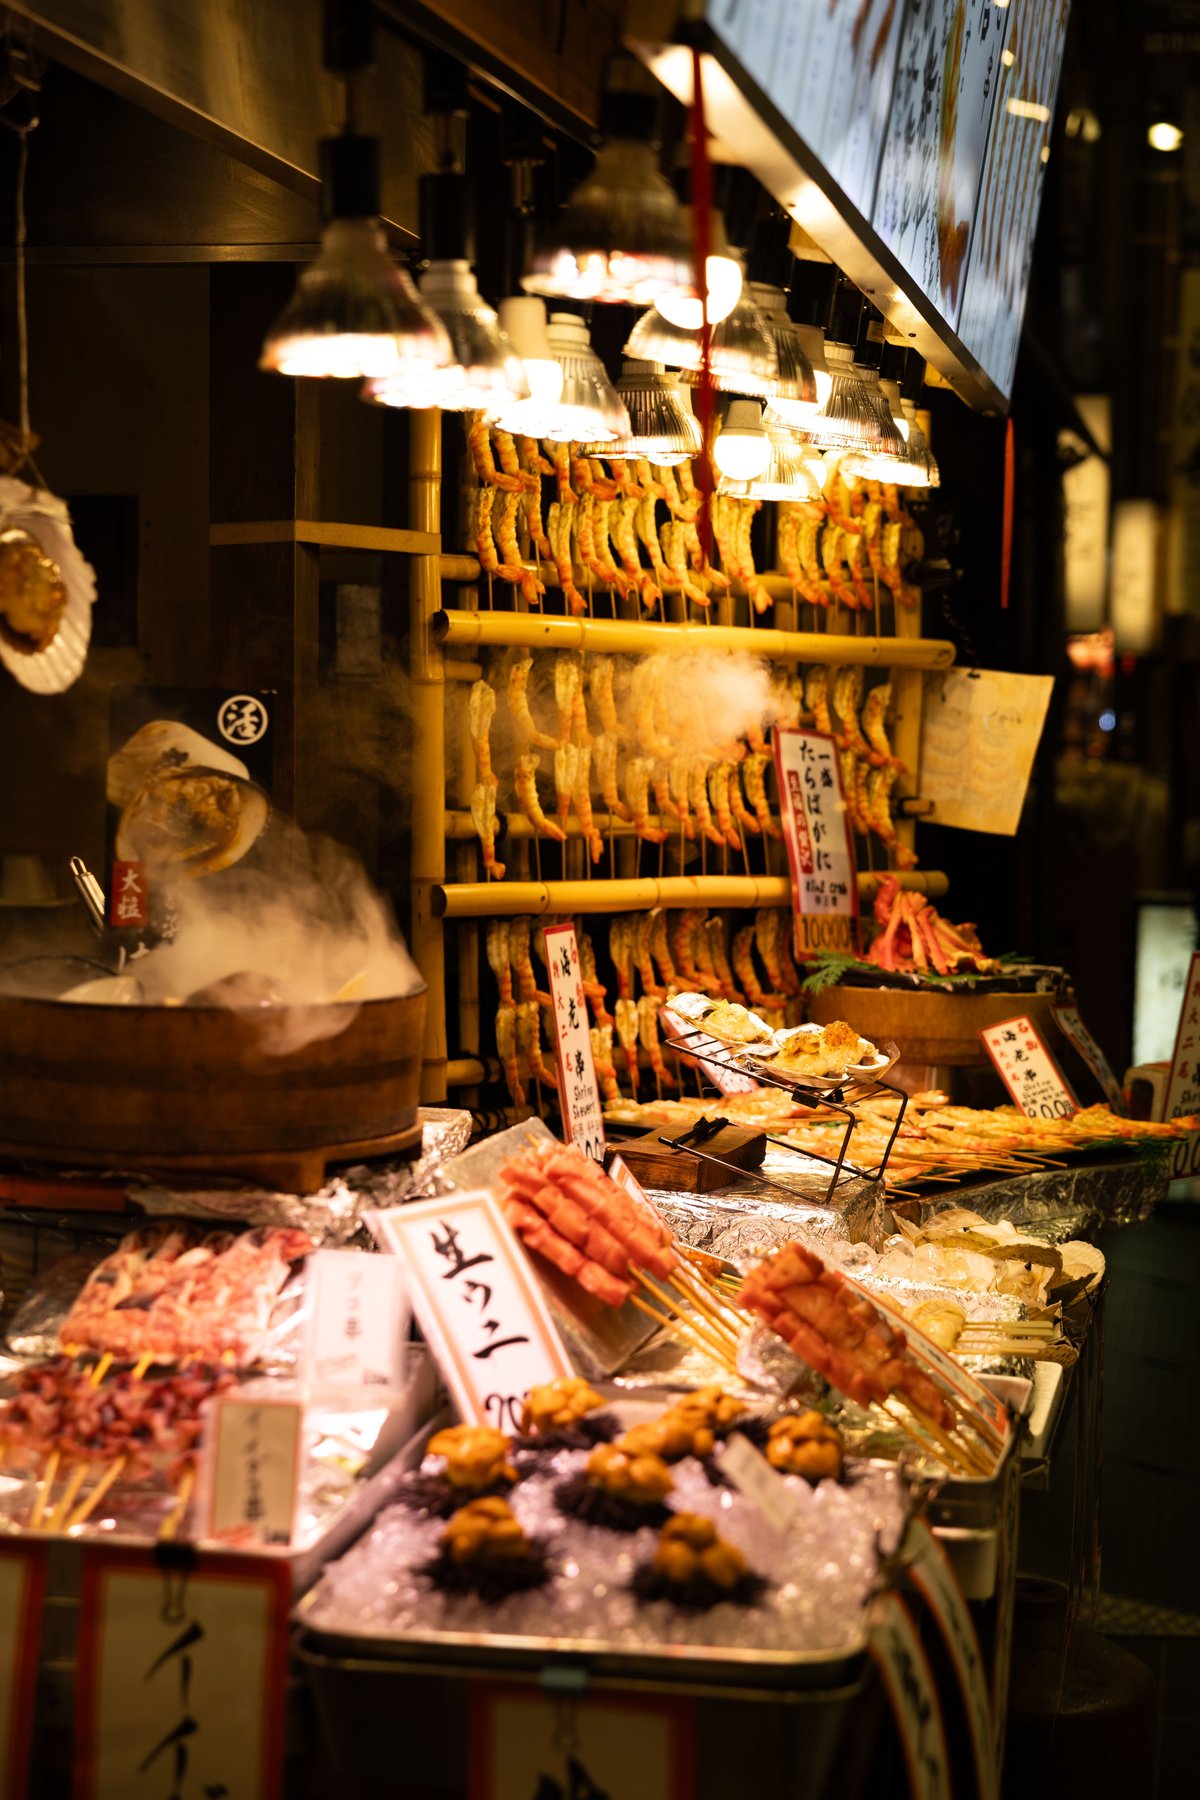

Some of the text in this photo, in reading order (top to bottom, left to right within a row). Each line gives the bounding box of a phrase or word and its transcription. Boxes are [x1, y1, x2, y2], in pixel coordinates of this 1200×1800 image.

[799, 739, 832, 871] たらばがに
[117, 868, 143, 920] 大粒
